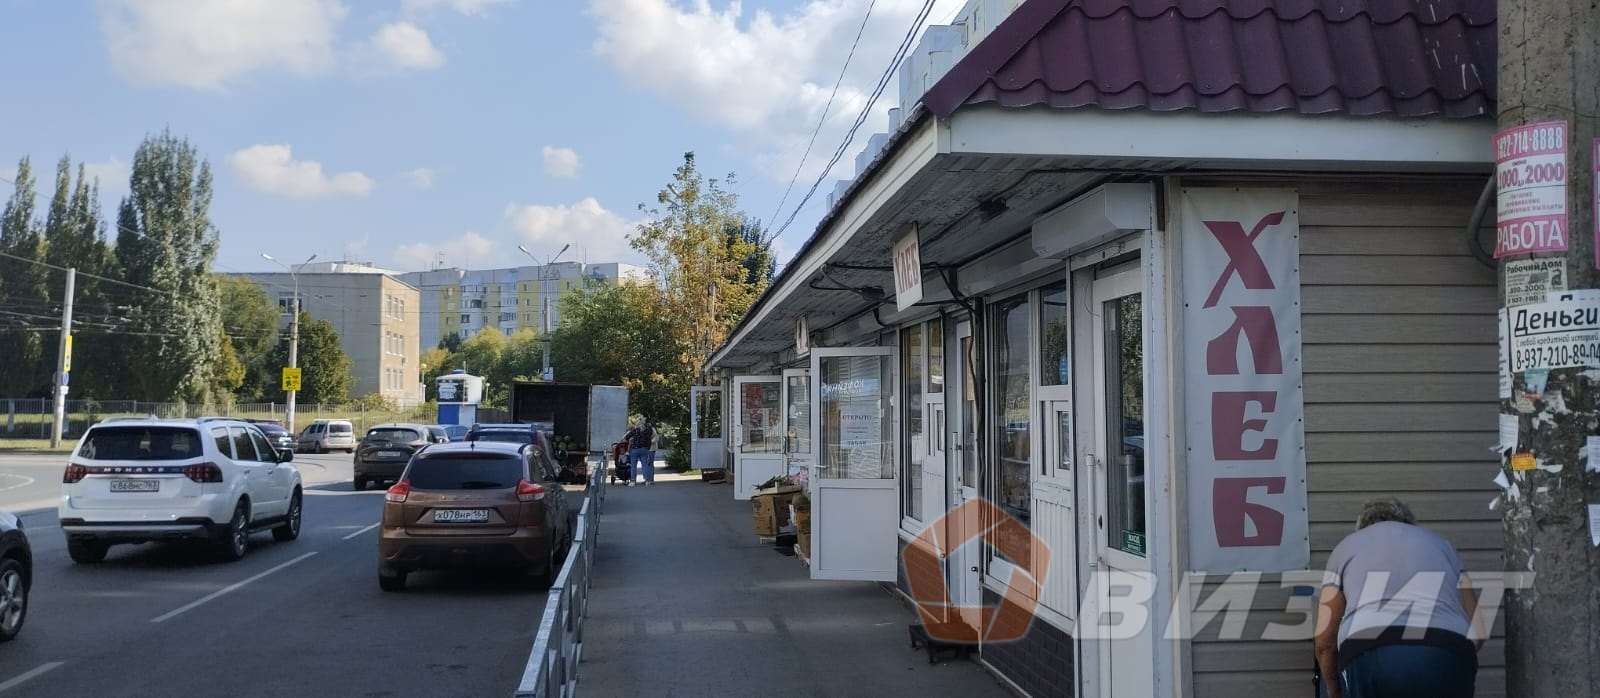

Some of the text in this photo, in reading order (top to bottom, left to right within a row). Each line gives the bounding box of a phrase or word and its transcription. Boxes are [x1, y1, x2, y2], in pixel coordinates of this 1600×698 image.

[1525, 162, 1565, 184] 2000
[1497, 219, 1565, 252] РАБОТА
[895, 241, 920, 294] ХЛЕБ
[1514, 307, 1599, 337] Деньги
[1201, 210, 1286, 548] ХЛЕБ
